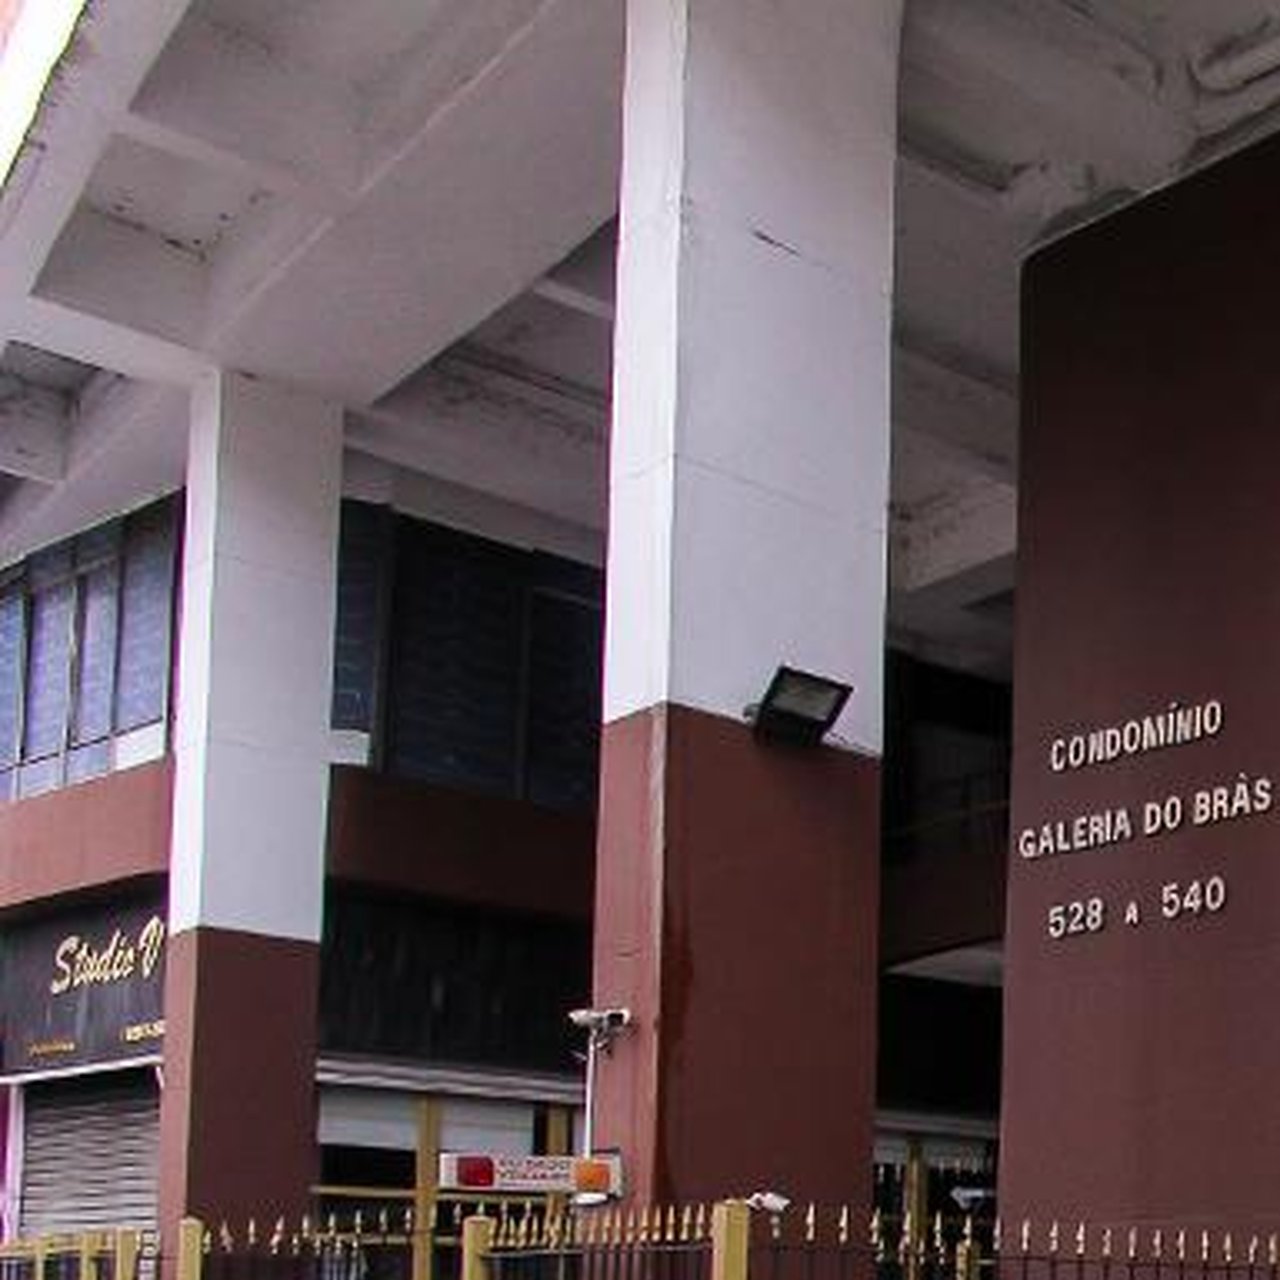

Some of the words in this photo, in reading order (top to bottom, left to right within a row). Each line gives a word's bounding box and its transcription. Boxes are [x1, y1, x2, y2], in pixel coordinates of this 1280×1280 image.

[1051, 700, 1222, 771] CONDOMÍNIO
[1018, 809, 1132, 859] GALERIA
[1144, 796, 1182, 835] DO
[1048, 897, 1104, 938] 528
[1125, 901, 1140, 925] A
[1162, 875, 1225, 919] 540
[50, 928, 136, 995] Studio
